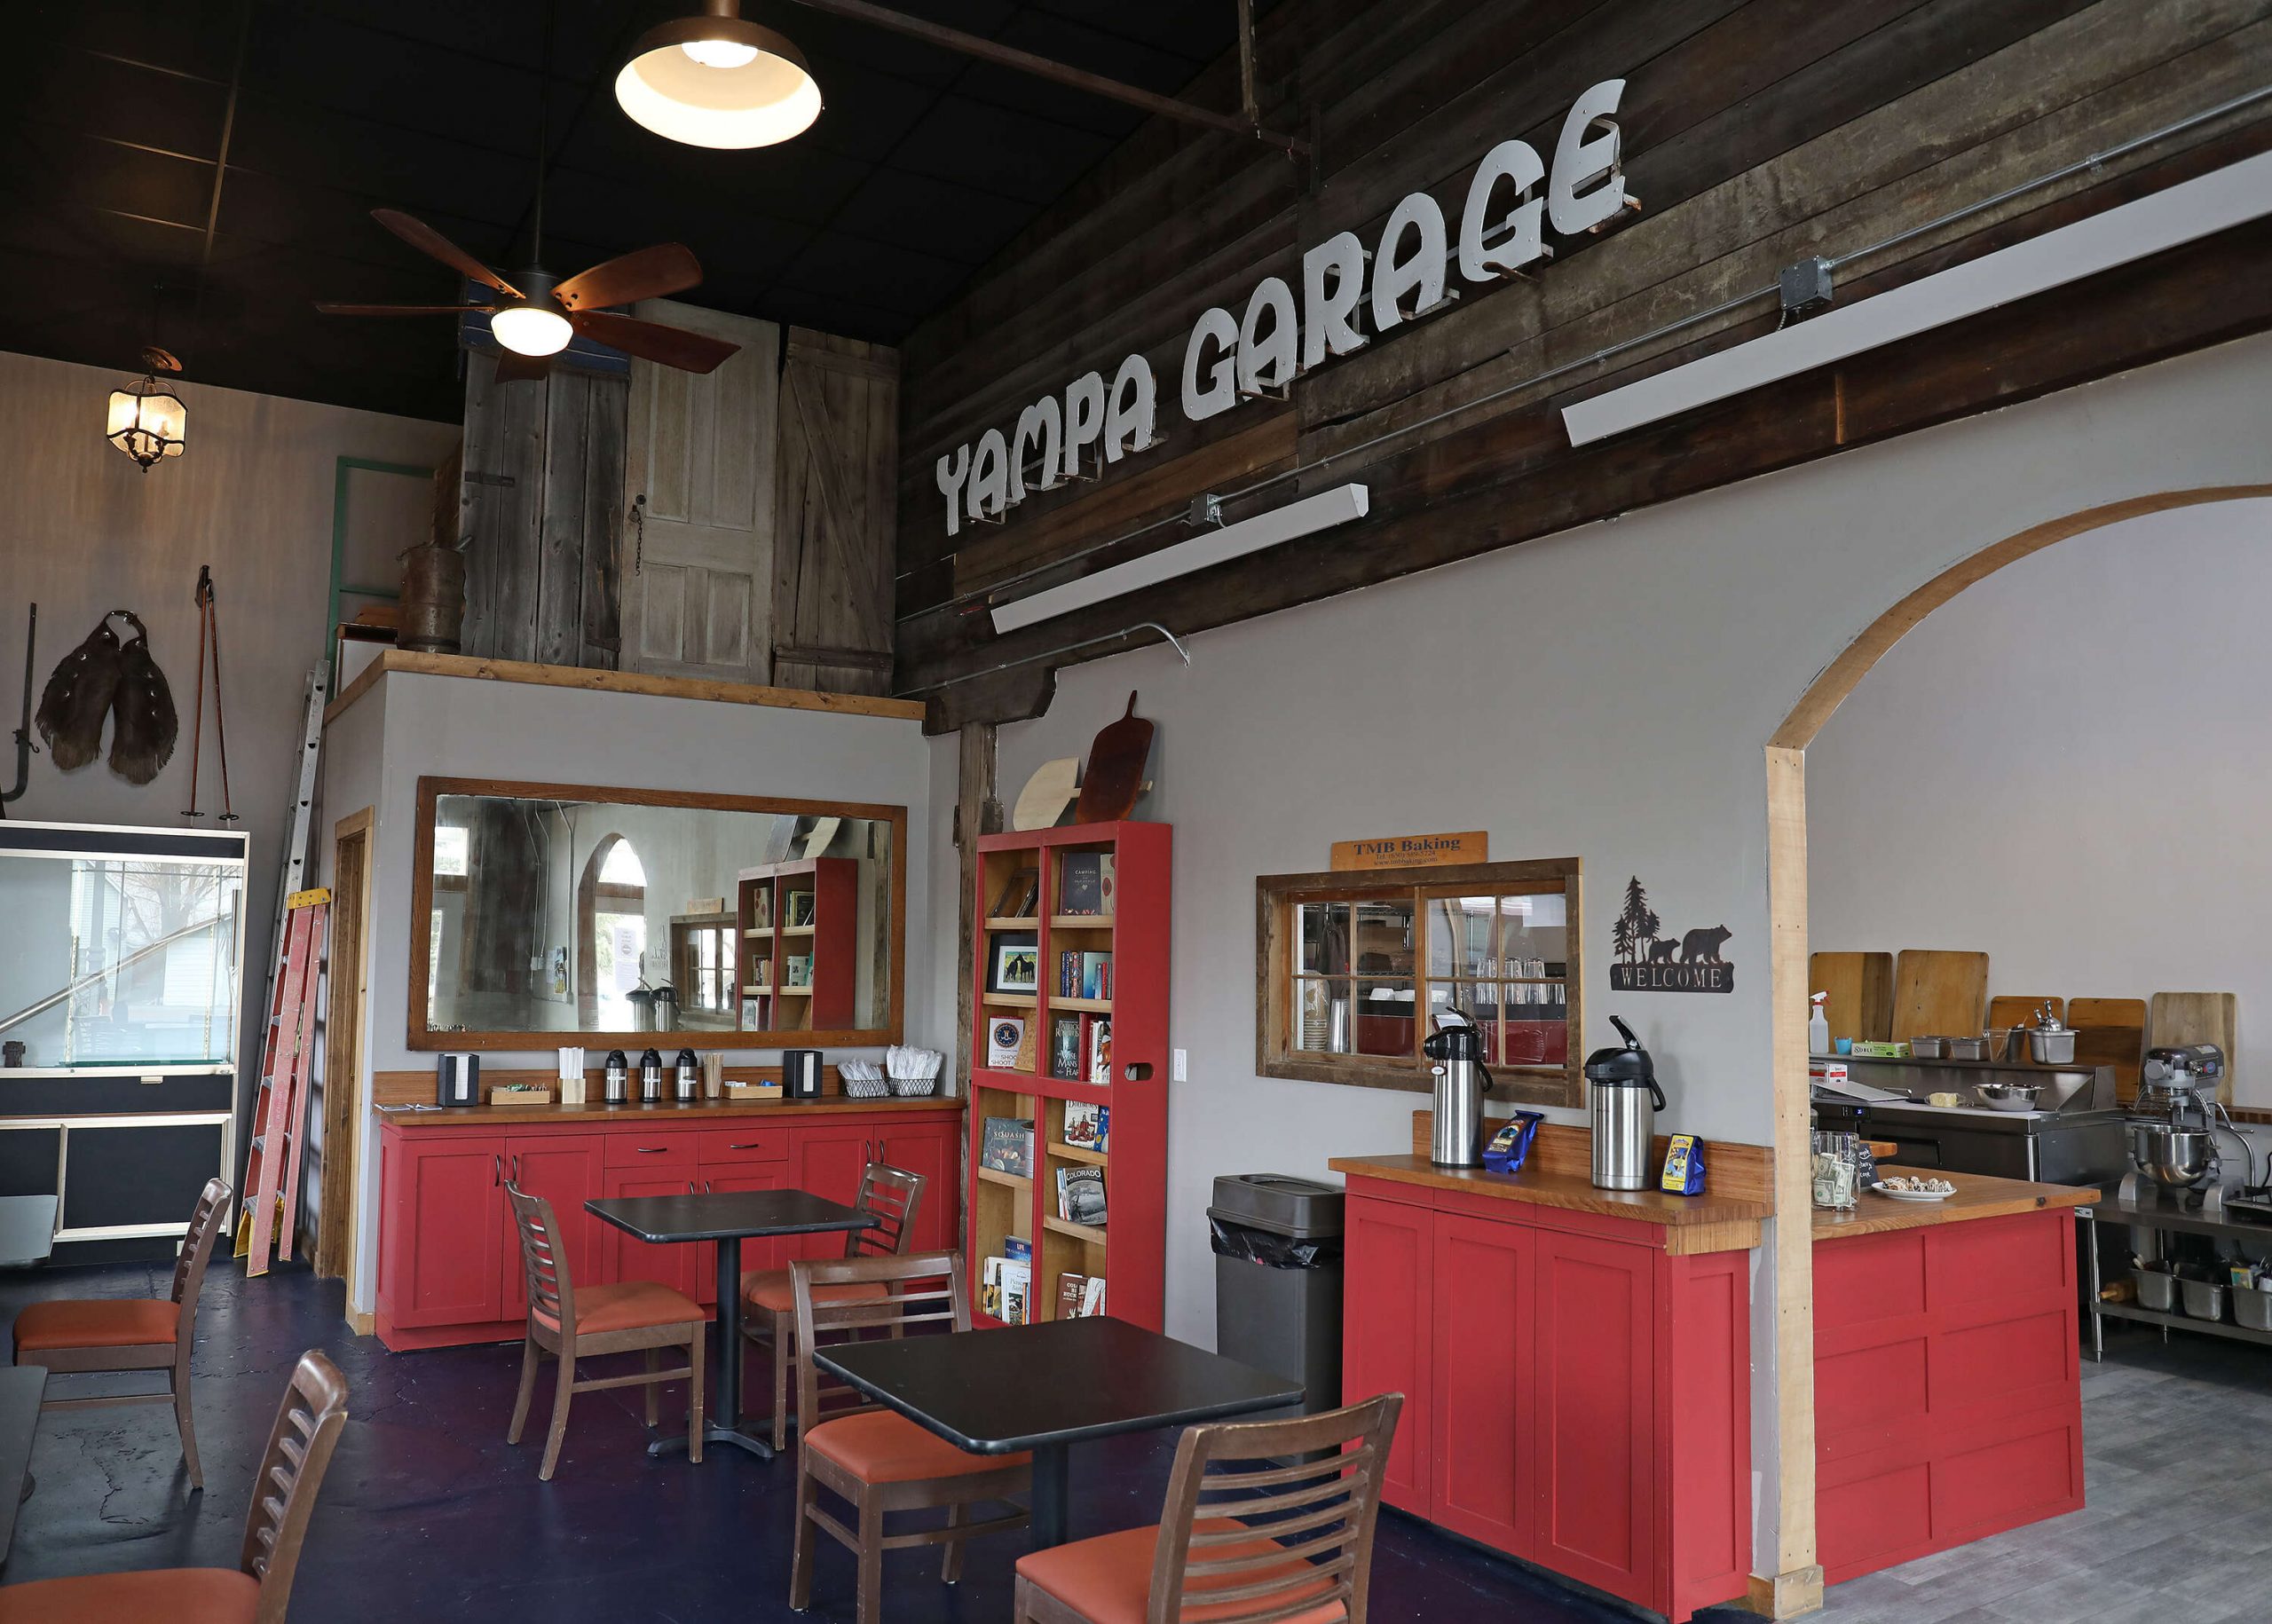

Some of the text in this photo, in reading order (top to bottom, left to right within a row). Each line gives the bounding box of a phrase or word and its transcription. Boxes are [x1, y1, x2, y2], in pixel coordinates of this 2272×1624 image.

[936, 78, 1627, 536] YAMPA GARAGE
[1353, 838, 1462, 855] TMB Baking
[1621, 967, 1723, 988] WELCOME
[993, 1131, 1025, 1139] SQUASH
[1066, 1170, 1101, 1181] COLORADO
